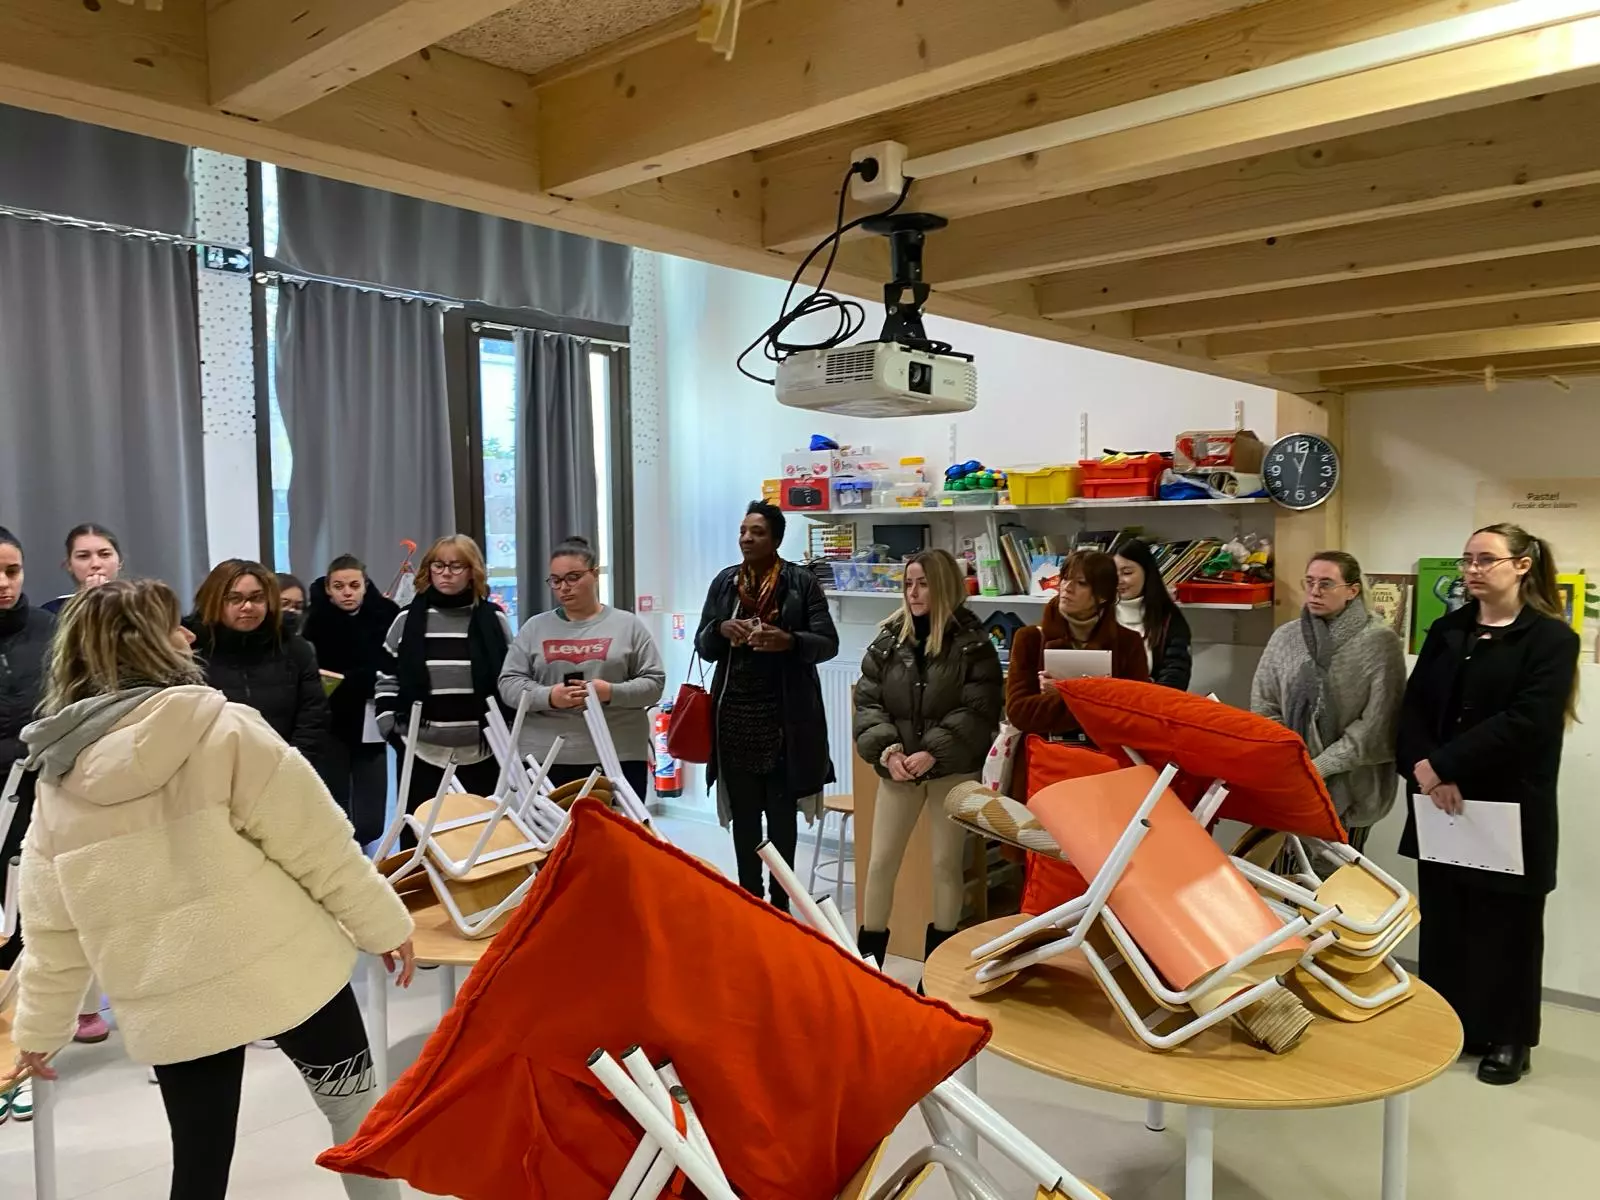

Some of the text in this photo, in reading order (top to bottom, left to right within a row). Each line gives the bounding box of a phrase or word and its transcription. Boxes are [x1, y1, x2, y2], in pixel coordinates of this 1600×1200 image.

[1295, 441, 1309, 453] 12
[1321, 454, 1329, 462] 2
[1271, 465, 1281, 476] 9
[1320, 465, 1332, 477] 3
[1295, 490, 1305, 500] 6
